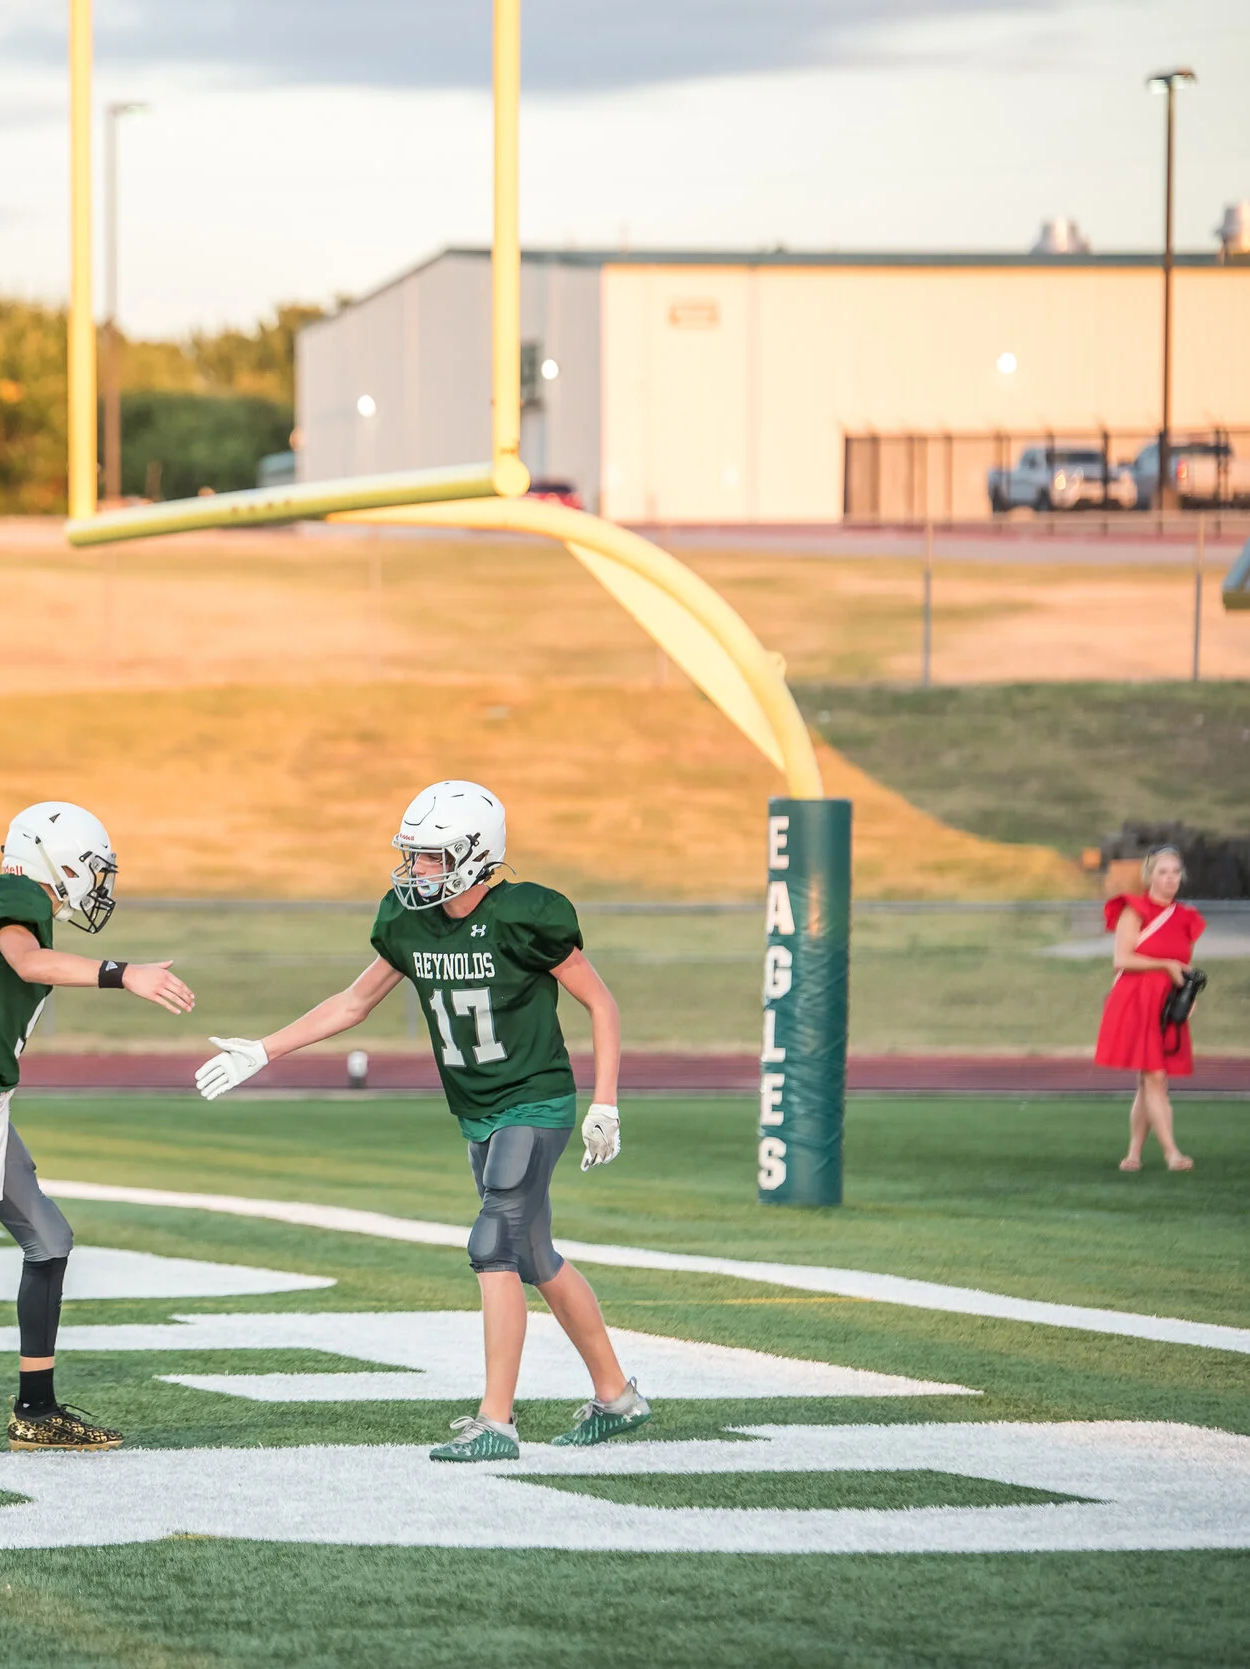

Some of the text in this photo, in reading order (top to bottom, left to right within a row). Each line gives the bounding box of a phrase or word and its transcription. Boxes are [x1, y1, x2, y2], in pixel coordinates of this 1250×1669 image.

[413, 952, 496, 980] REYNOLDS
[757, 815, 795, 1191] EAGLES
[429, 986, 508, 1068] 17
